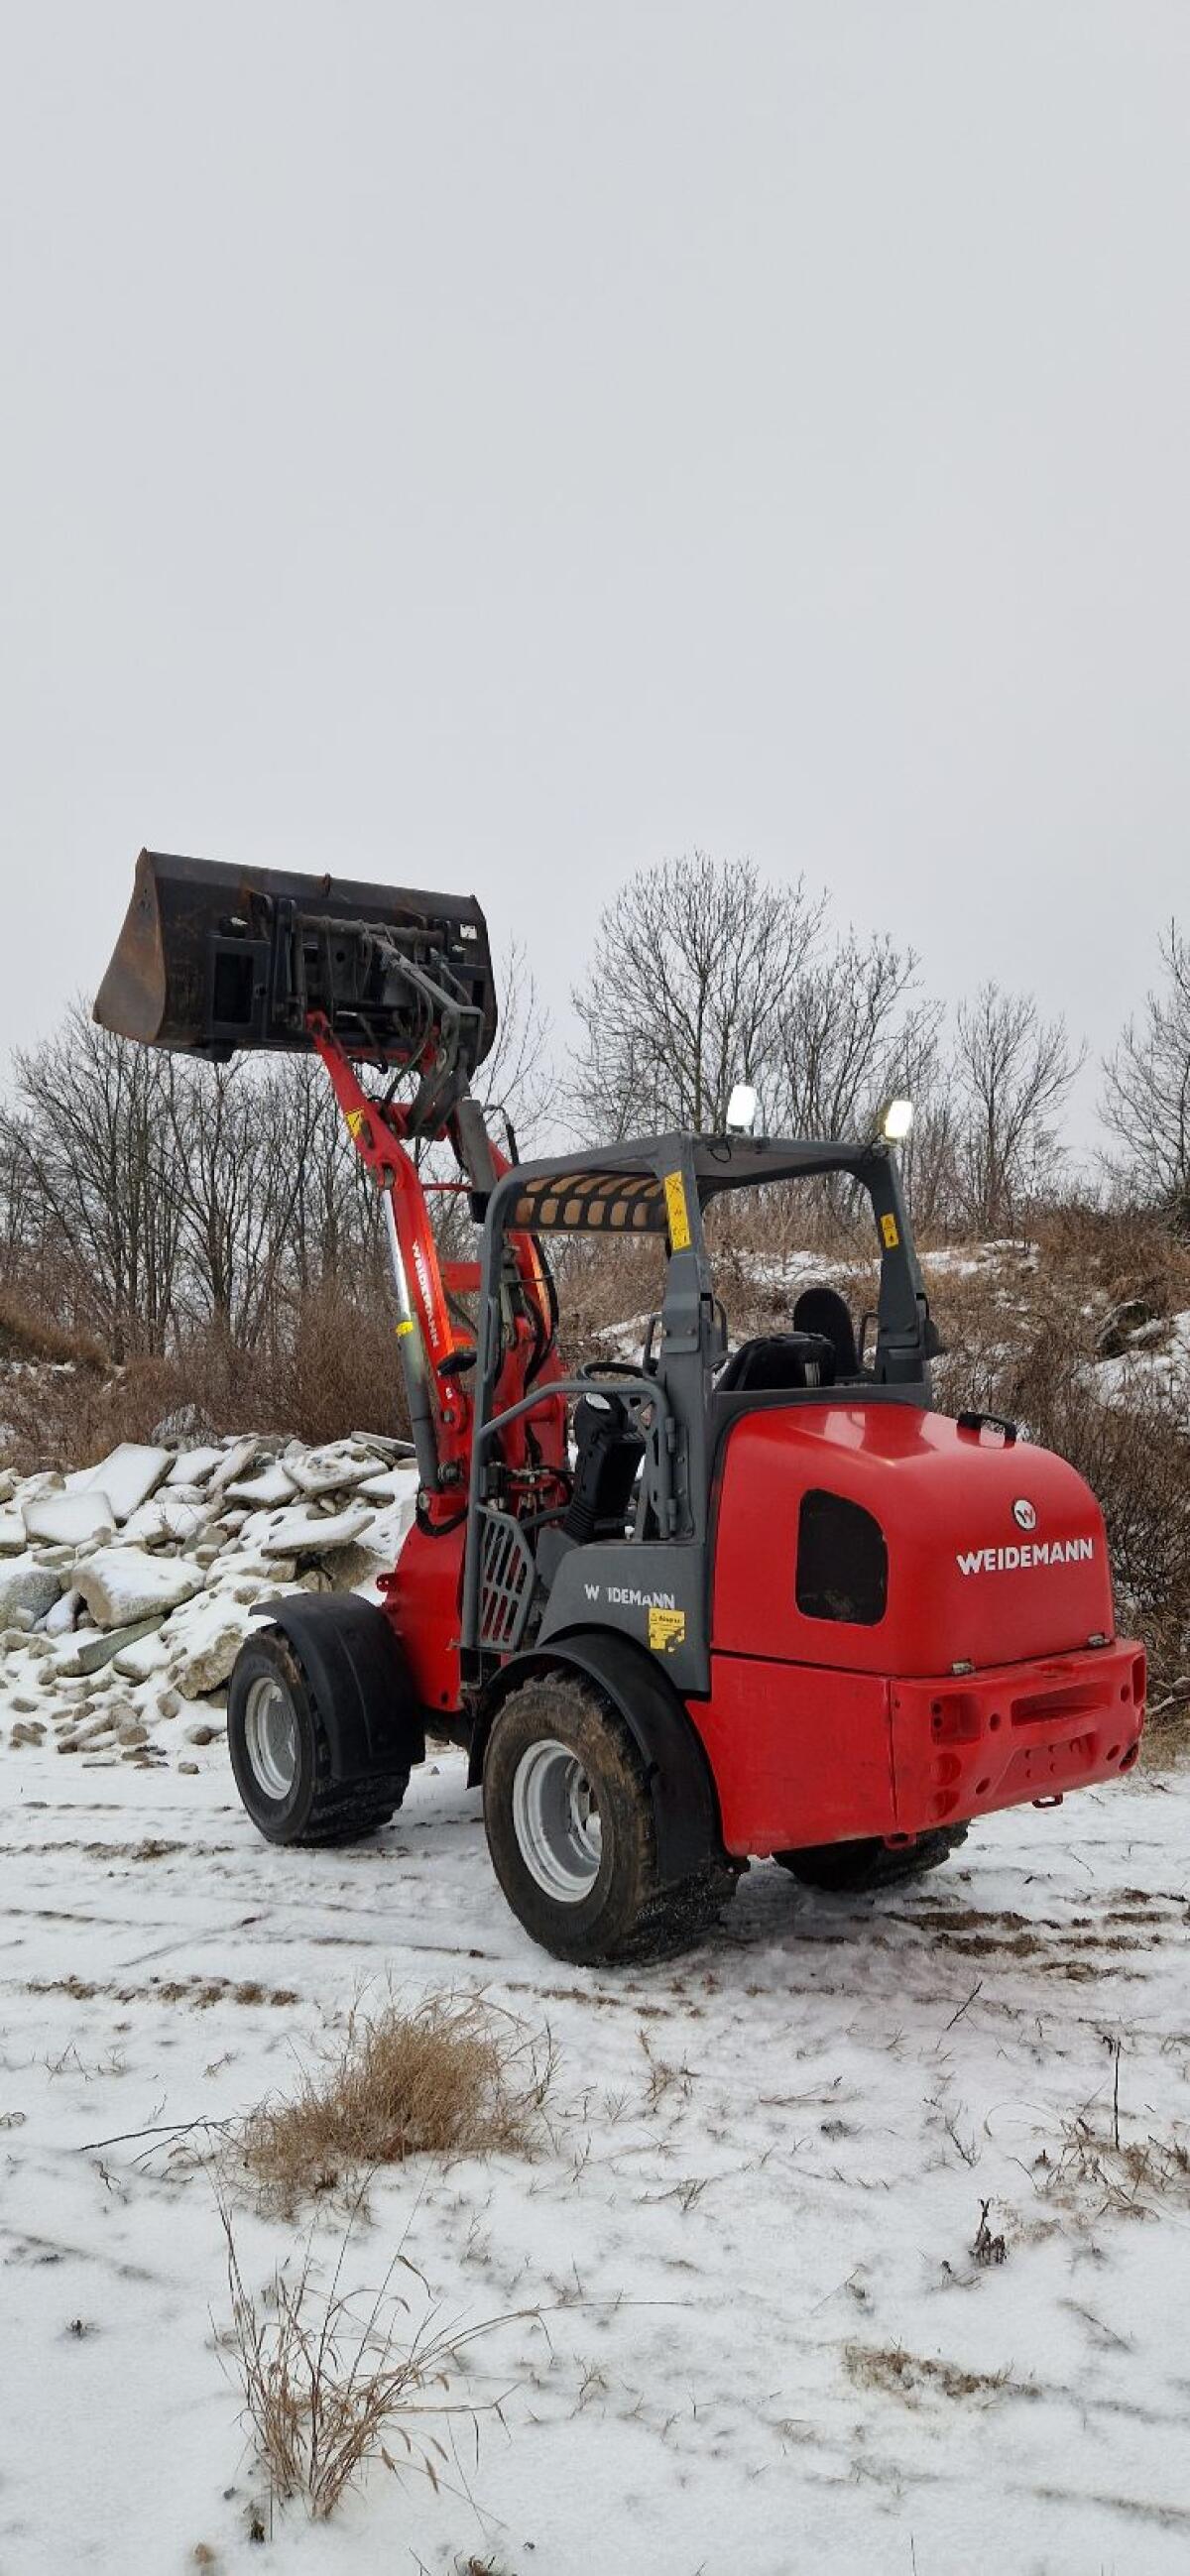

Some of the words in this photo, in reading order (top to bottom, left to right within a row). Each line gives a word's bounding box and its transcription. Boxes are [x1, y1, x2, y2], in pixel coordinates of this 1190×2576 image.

[413, 1238, 439, 1347] WEIDEMANN
[956, 1538, 1093, 1576] WEIDEMANN
[584, 1583, 675, 1609] WIDEMANN
